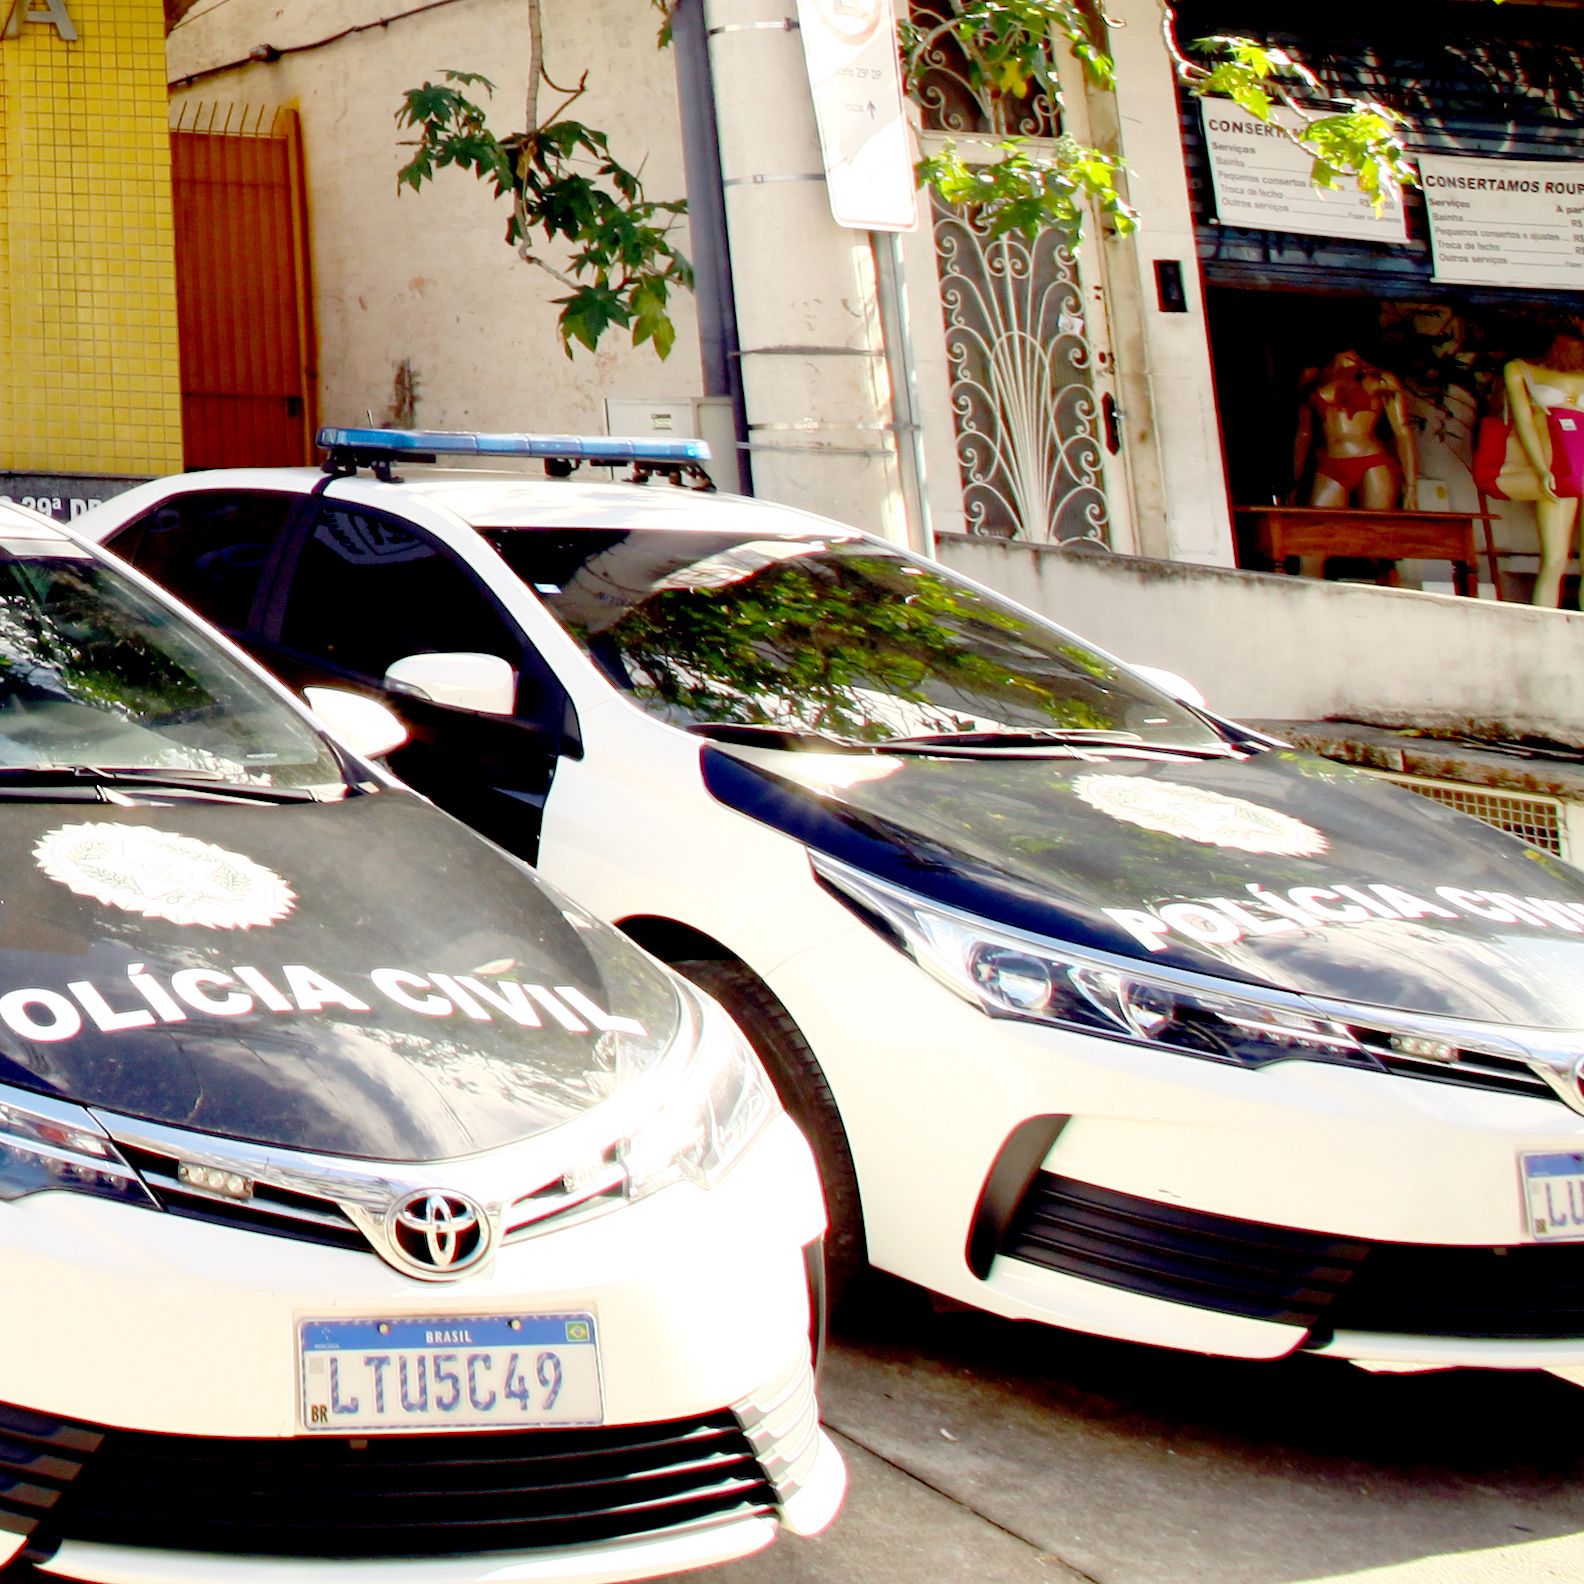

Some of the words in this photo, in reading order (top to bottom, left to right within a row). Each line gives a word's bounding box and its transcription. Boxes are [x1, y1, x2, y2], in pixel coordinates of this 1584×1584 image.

[1212, 141, 1256, 154] Serviços
[1425, 175, 1540, 193] CONSERTAMOS
[1429, 198, 1471, 209] Serviços
[1100, 882, 1460, 953] POLÍCIA
[369, 967, 650, 1038] CIVIL
[1544, 1181, 1584, 1228] LU
[425, 1330, 473, 1344] BRASIL
[329, 1351, 564, 1415] LTU5C49
[310, 1404, 328, 1424] BR
